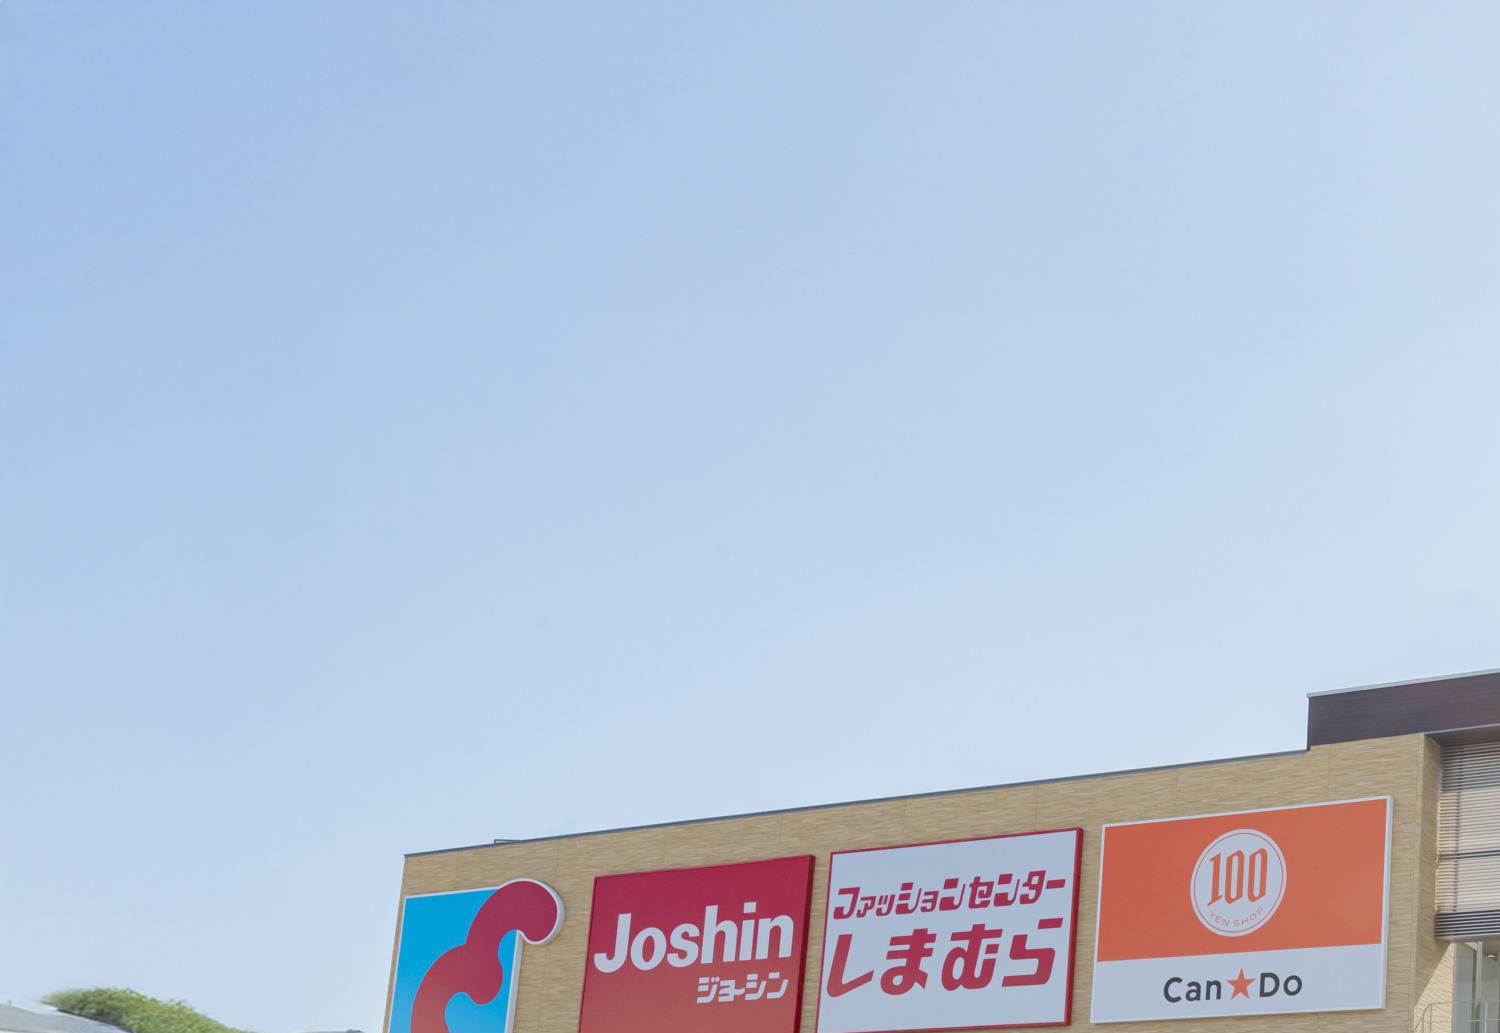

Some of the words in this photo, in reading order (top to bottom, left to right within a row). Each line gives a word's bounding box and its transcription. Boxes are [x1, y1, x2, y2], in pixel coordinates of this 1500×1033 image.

[833, 870, 1066, 920] ファッションセンター
[1207, 848, 1268, 906] 100
[594, 901, 794, 973] Joshin
[1209, 911, 1230, 926] YEN
[1233, 906, 1263, 927] SHOP
[826, 917, 1063, 998] しまむら
[697, 972, 789, 1003] ジョーシン
